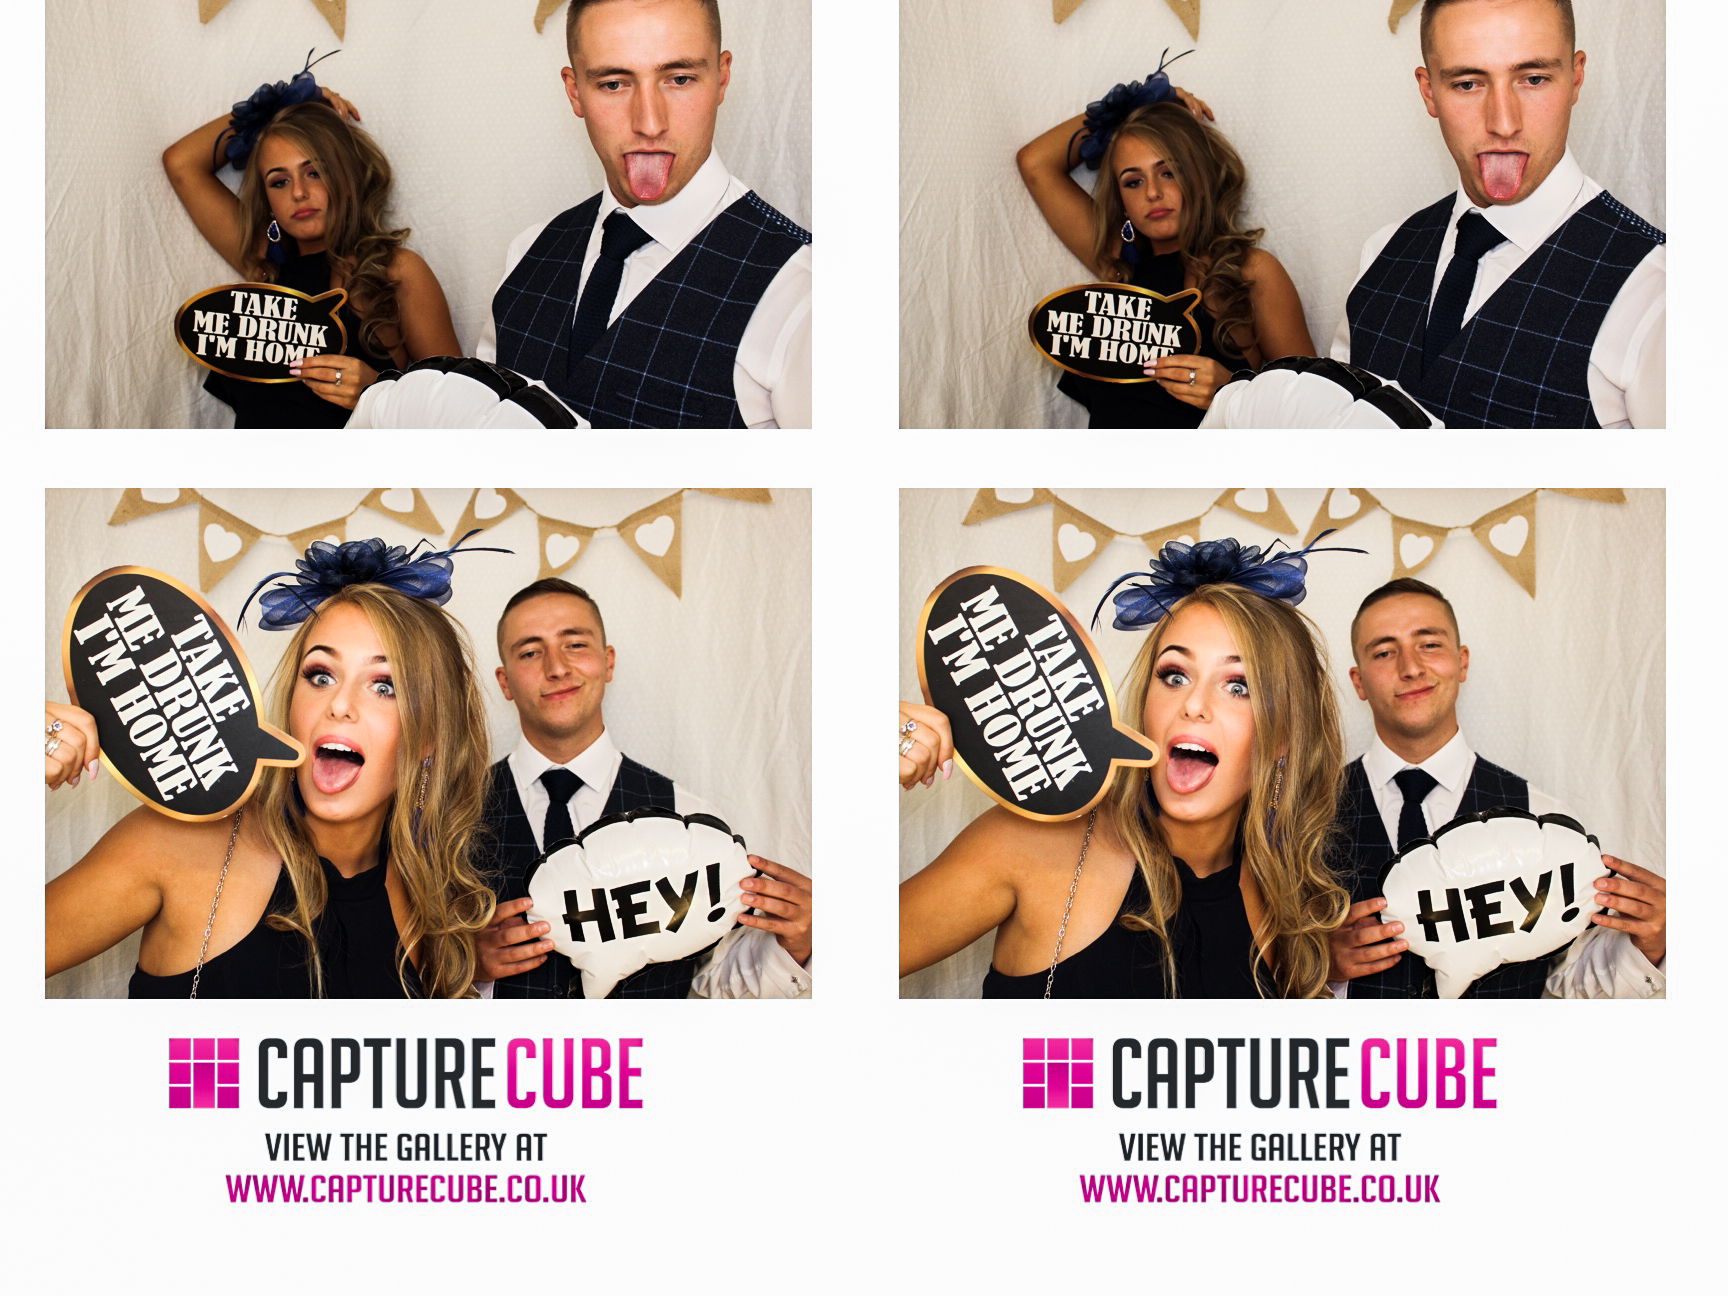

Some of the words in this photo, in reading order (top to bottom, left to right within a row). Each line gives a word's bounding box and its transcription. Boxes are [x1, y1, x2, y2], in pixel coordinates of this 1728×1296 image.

[193, 310, 230, 336] ME
[237, 315, 328, 348] DRUNK
[196, 333, 237, 359] I'M
[231, 290, 298, 321] TAKE
[1047, 310, 1084, 336] ME
[1091, 315, 1182, 348] DRUNK
[1050, 333, 1091, 359] I'M
[1085, 290, 1152, 321] TAKE
[73, 612, 136, 687] I'M
[109, 681, 198, 802] HOME
[106, 584, 166, 652] ME
[139, 647, 239, 792] DRUNK
[171, 612, 251, 723] TAKE
[927, 612, 990, 687] I'M
[963, 681, 1052, 802] HOME
[960, 584, 1020, 652] ME
[993, 647, 1093, 792] DRUNK
[1025, 612, 1105, 723] TAKE
[562, 862, 726, 943] HEY!
[1416, 862, 1580, 943] HEY!
